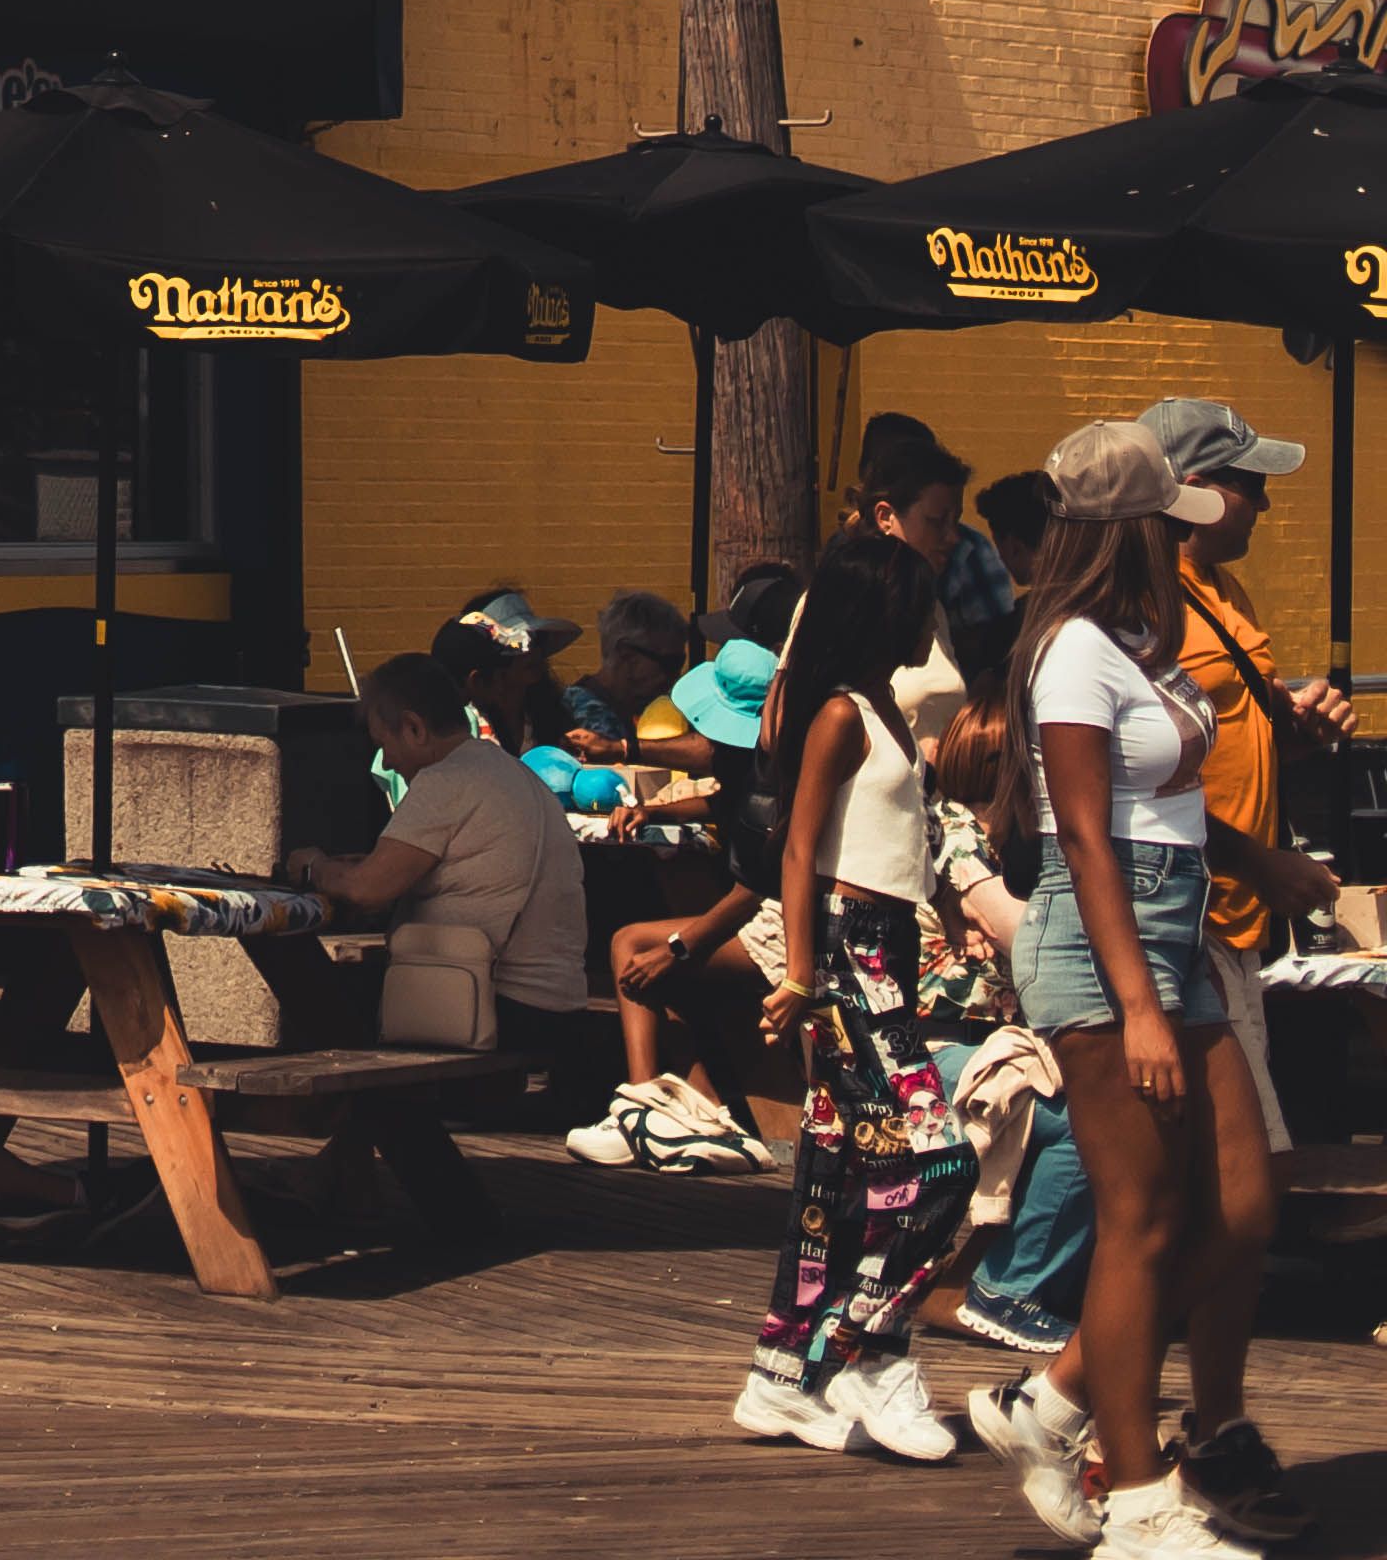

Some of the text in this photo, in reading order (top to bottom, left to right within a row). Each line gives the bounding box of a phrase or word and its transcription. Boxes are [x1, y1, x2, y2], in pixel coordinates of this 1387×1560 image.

[926, 226, 1099, 286] Nathan's
[127, 271, 351, 324] Nathan's
[988, 287, 1046, 299] FAMOUS
[206, 328, 277, 337] FAMOUS
